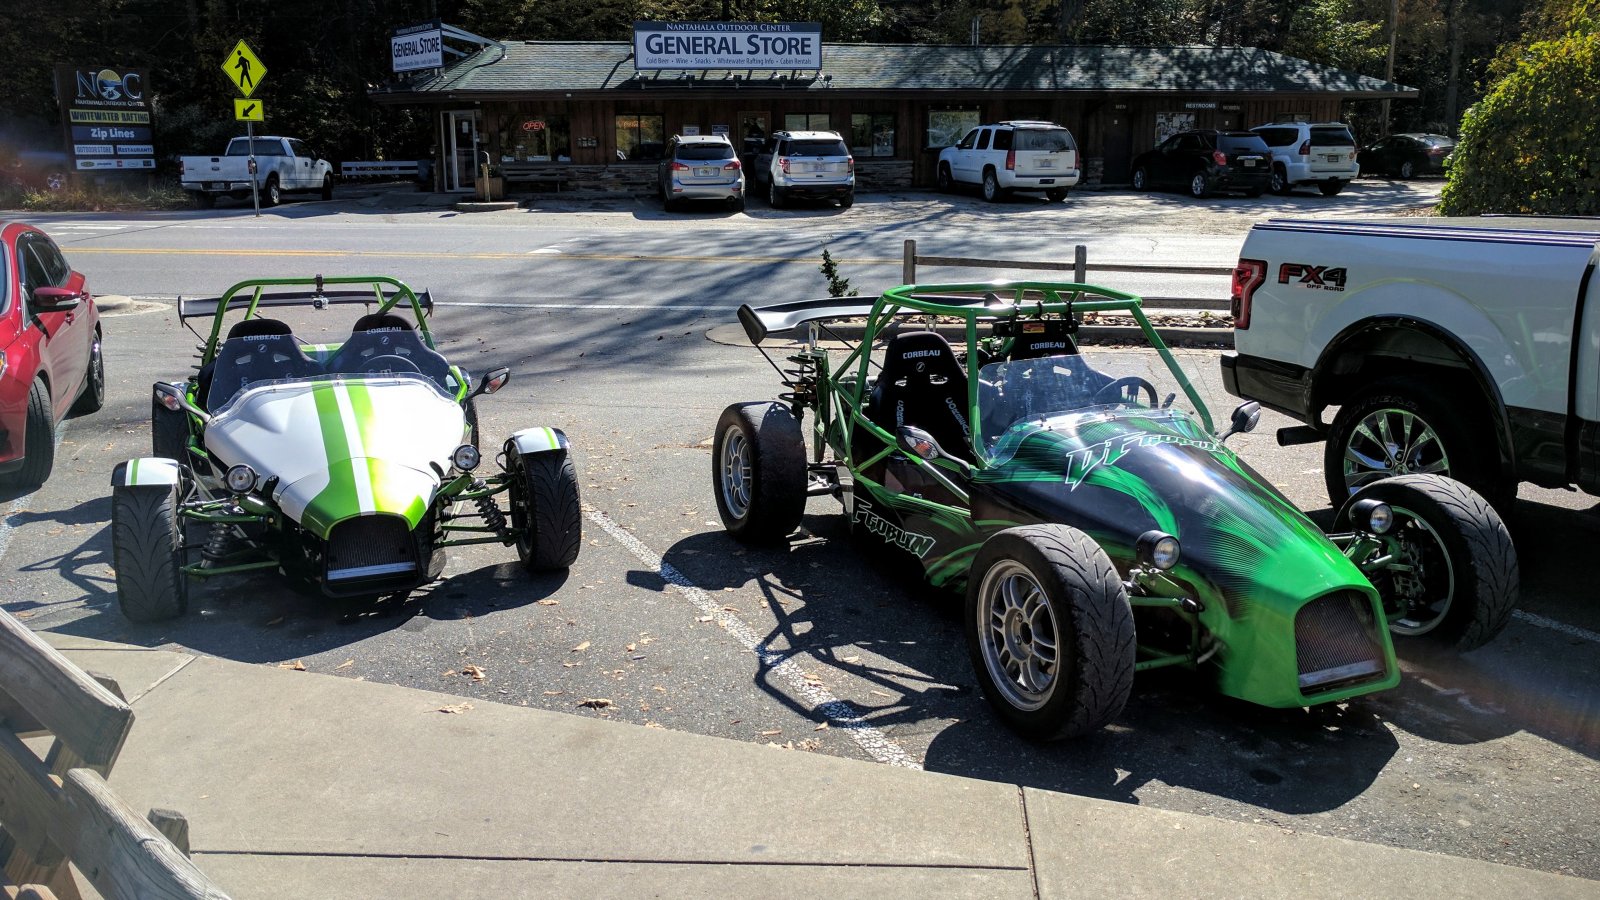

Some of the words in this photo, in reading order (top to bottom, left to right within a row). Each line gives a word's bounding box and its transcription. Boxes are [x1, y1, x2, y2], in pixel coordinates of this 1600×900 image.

[666, 23, 715, 31] NANTAHALA
[716, 23, 758, 32] OUTDOOR
[760, 23, 792, 32] CENTER
[393, 40, 420, 58] GENERAL
[419, 37, 440, 54] STORE
[645, 33, 744, 55] GENERAL
[746, 34, 812, 55] STORE
[646, 57, 657, 65] Cold
[658, 57, 669, 65] Beer
[675, 57, 688, 65] Wine
[695, 57, 711, 65] Snacks
[717, 57, 745, 65] Whitewater
[746, 57, 764, 66] Rafting
[764, 57, 775, 65] Info
[780, 57, 794, 65] Cabin
[795, 57, 812, 66] Rentals
[76, 69, 142, 100] NOC
[71, 111, 119, 121] WHITEWATER
[523, 121, 546, 131] OPEN
[90, 128, 107, 140] Zip
[109, 128, 135, 138] Lines
[1278, 262, 1348, 288] FX4
[366, 326, 402, 335] CORBEAU
[1030, 341, 1066, 350] CORBEAU
[903, 349, 941, 360] CORBEAU
